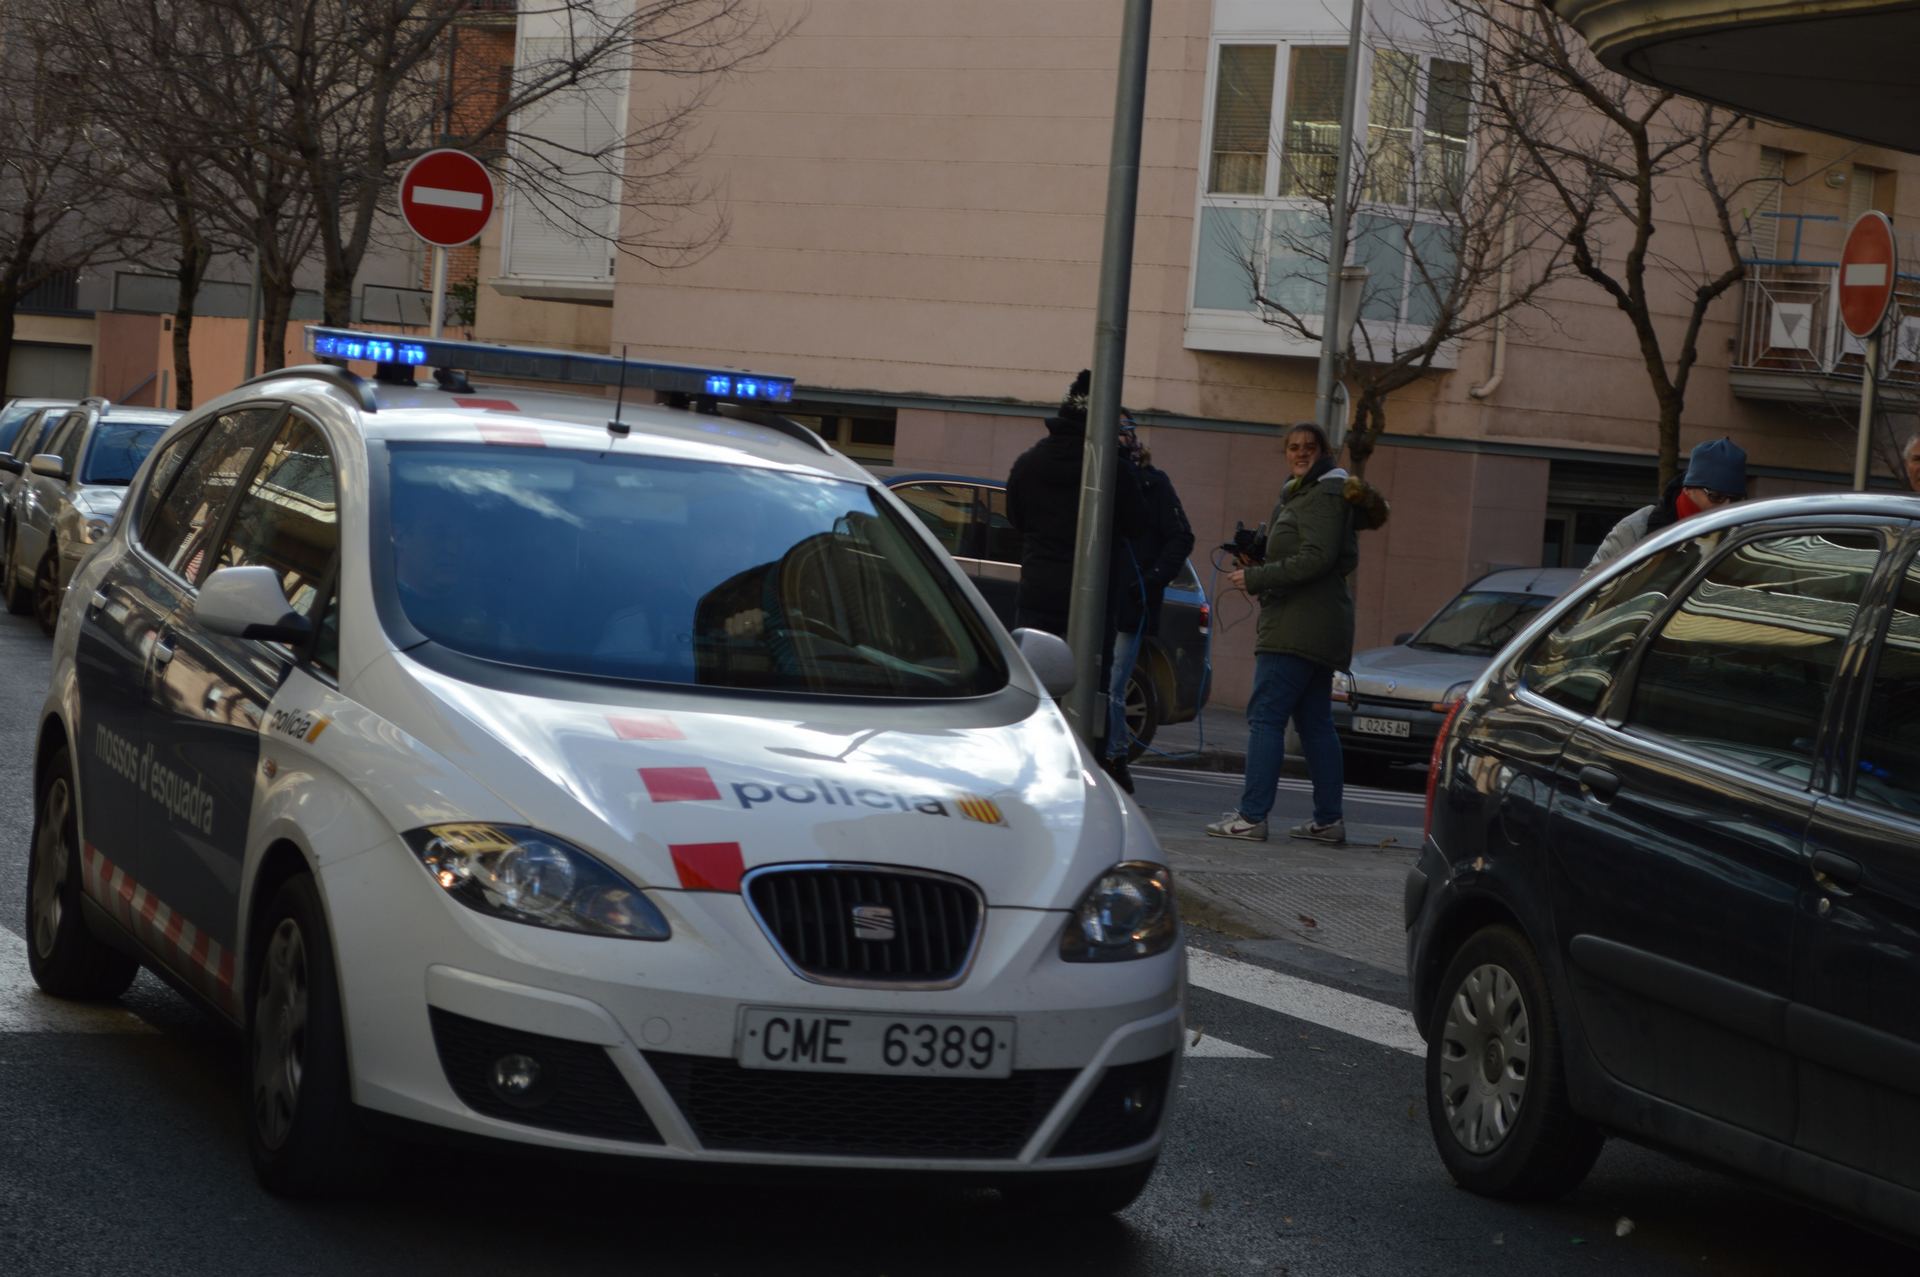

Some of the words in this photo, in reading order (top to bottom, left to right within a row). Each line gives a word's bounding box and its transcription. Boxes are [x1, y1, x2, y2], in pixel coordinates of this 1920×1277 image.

[95, 722, 139, 784] mossos
[140, 741, 214, 835] d'esquadra
[729, 778, 951, 818] policia
[762, 1016, 852, 1064] CME
[882, 1022, 995, 1070] 6389
